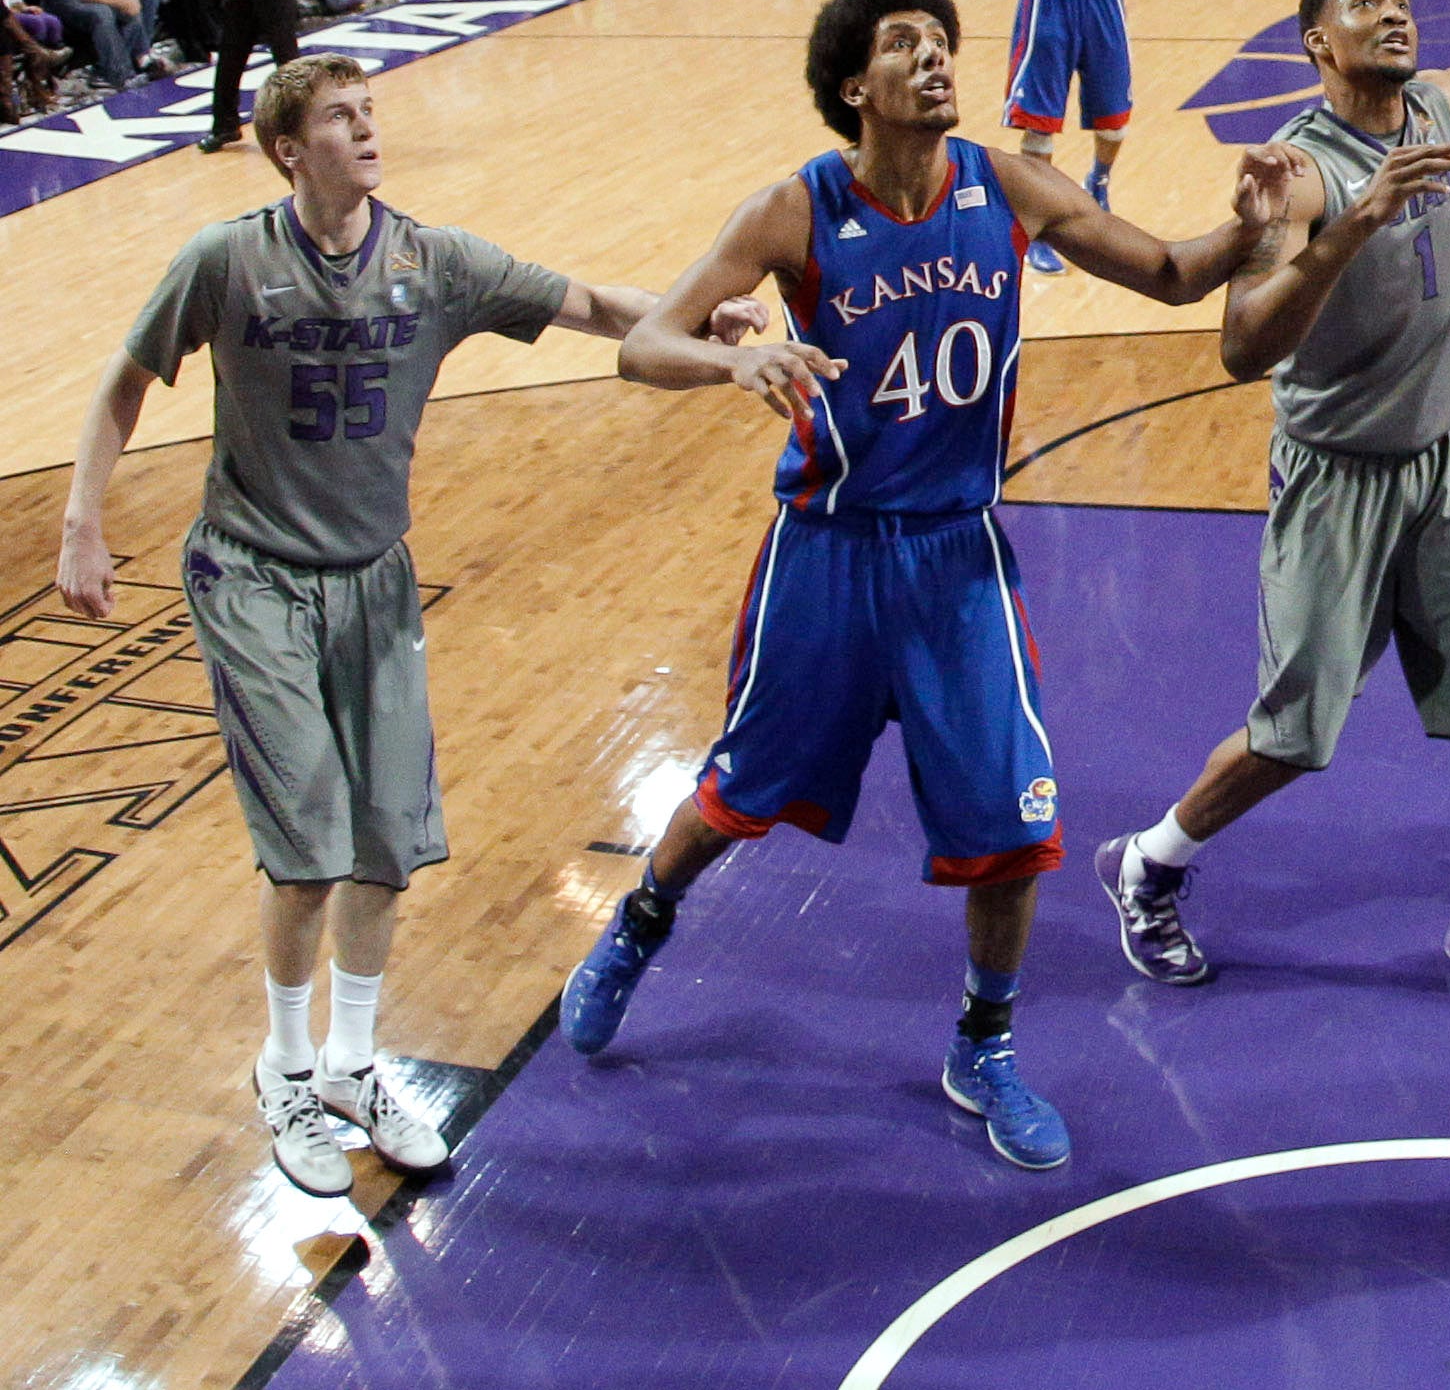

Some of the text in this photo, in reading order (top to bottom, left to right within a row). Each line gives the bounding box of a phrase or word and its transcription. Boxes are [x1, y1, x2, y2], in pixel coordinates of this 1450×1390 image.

[828, 256, 1009, 326] KANSAS
[1412, 224, 1440, 302] 1
[243, 312, 420, 352] K-STATE
[870, 318, 993, 423] 40
[289, 361, 390, 442] 55
